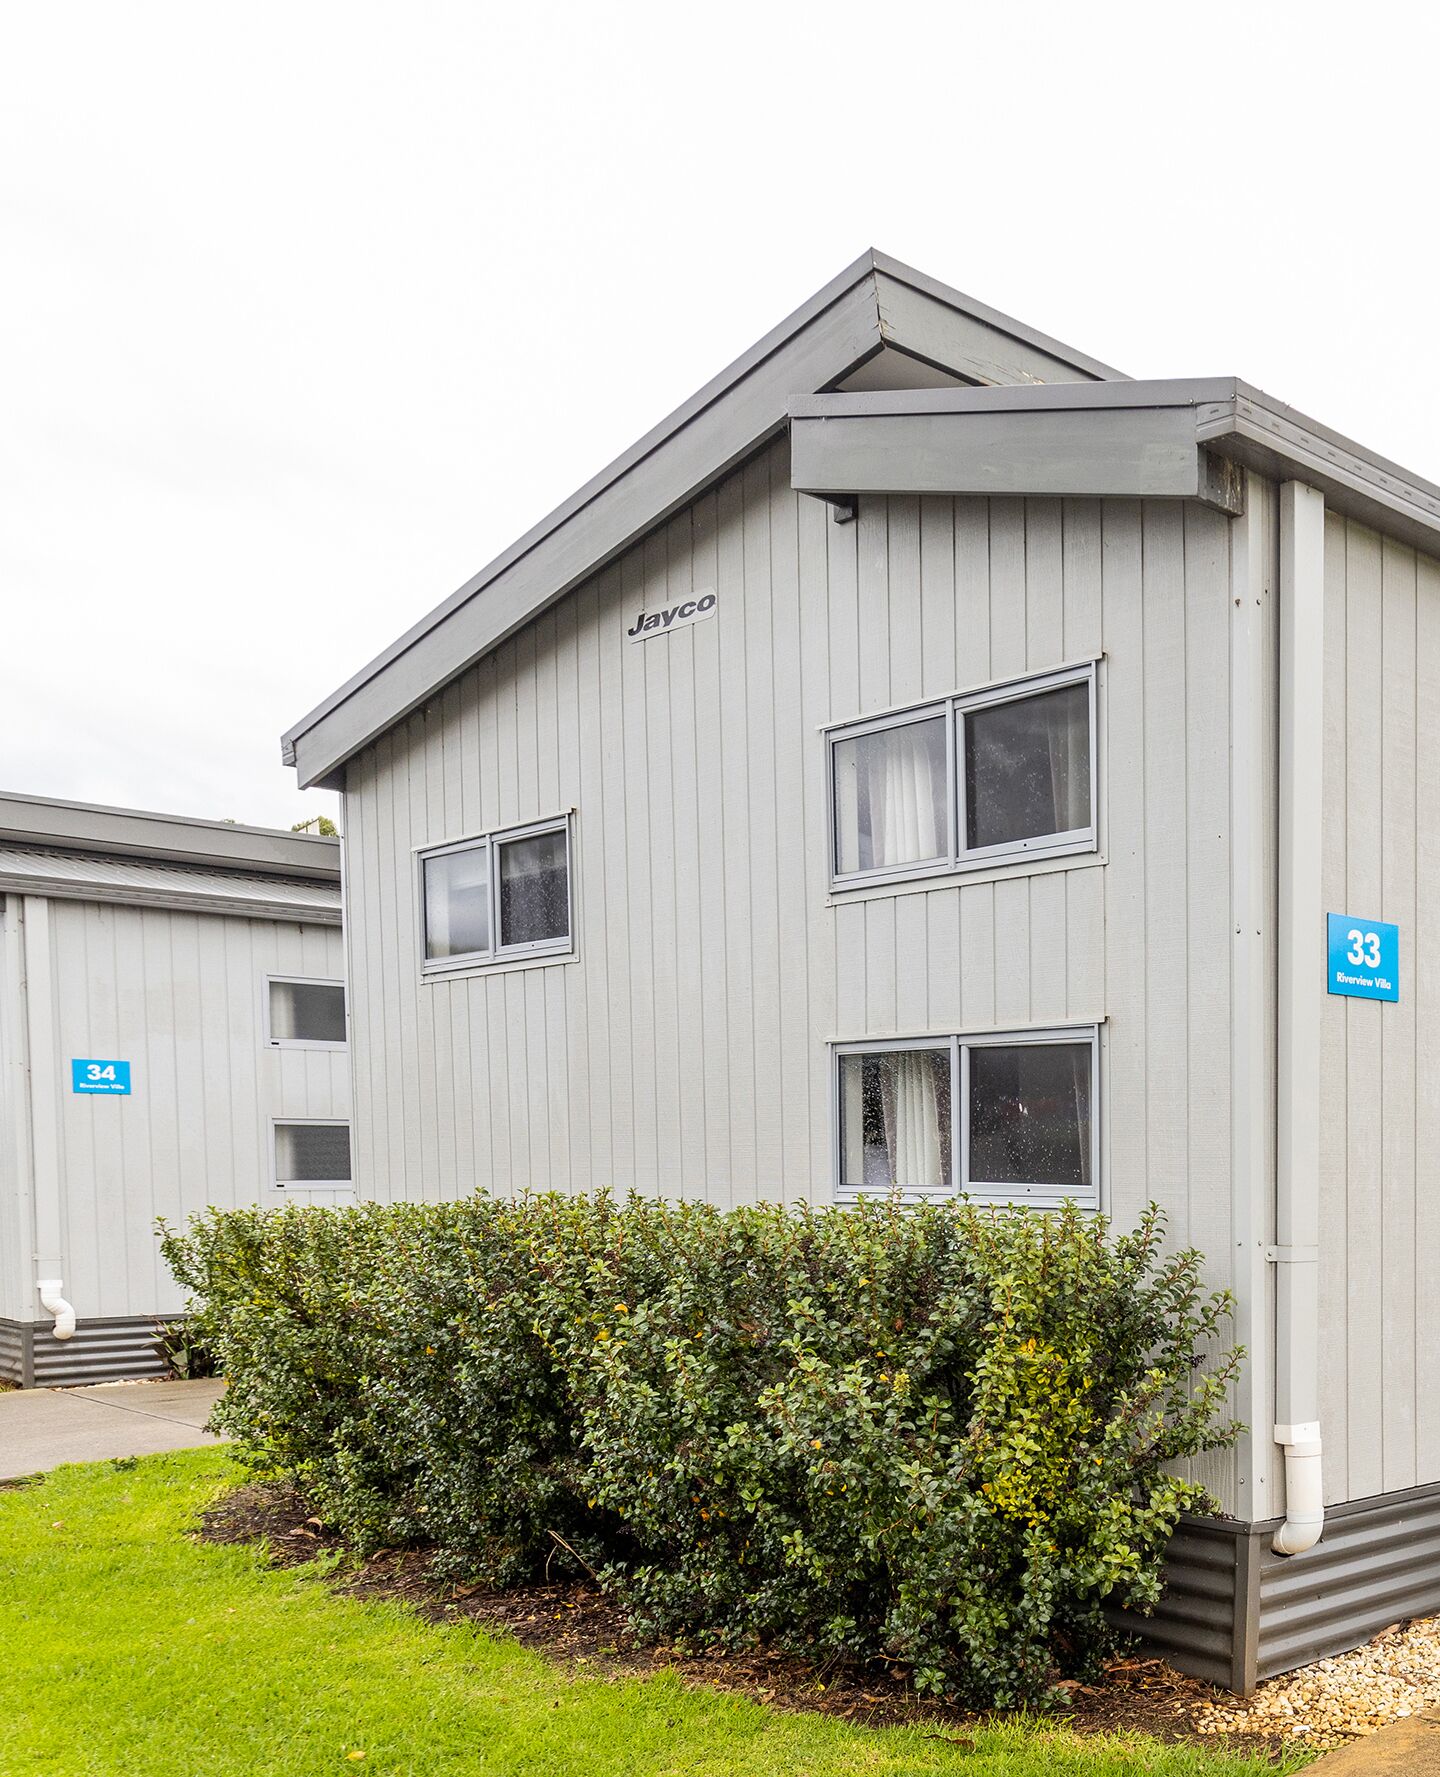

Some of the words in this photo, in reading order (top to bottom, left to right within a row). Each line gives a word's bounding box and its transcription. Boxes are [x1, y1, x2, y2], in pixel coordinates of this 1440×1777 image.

[628, 594, 716, 636] Jayco
[1347, 929, 1381, 968] 33
[1336, 971, 1374, 987] Riverview
[1374, 977, 1392, 990] Villa
[87, 1064, 116, 1081] 34
